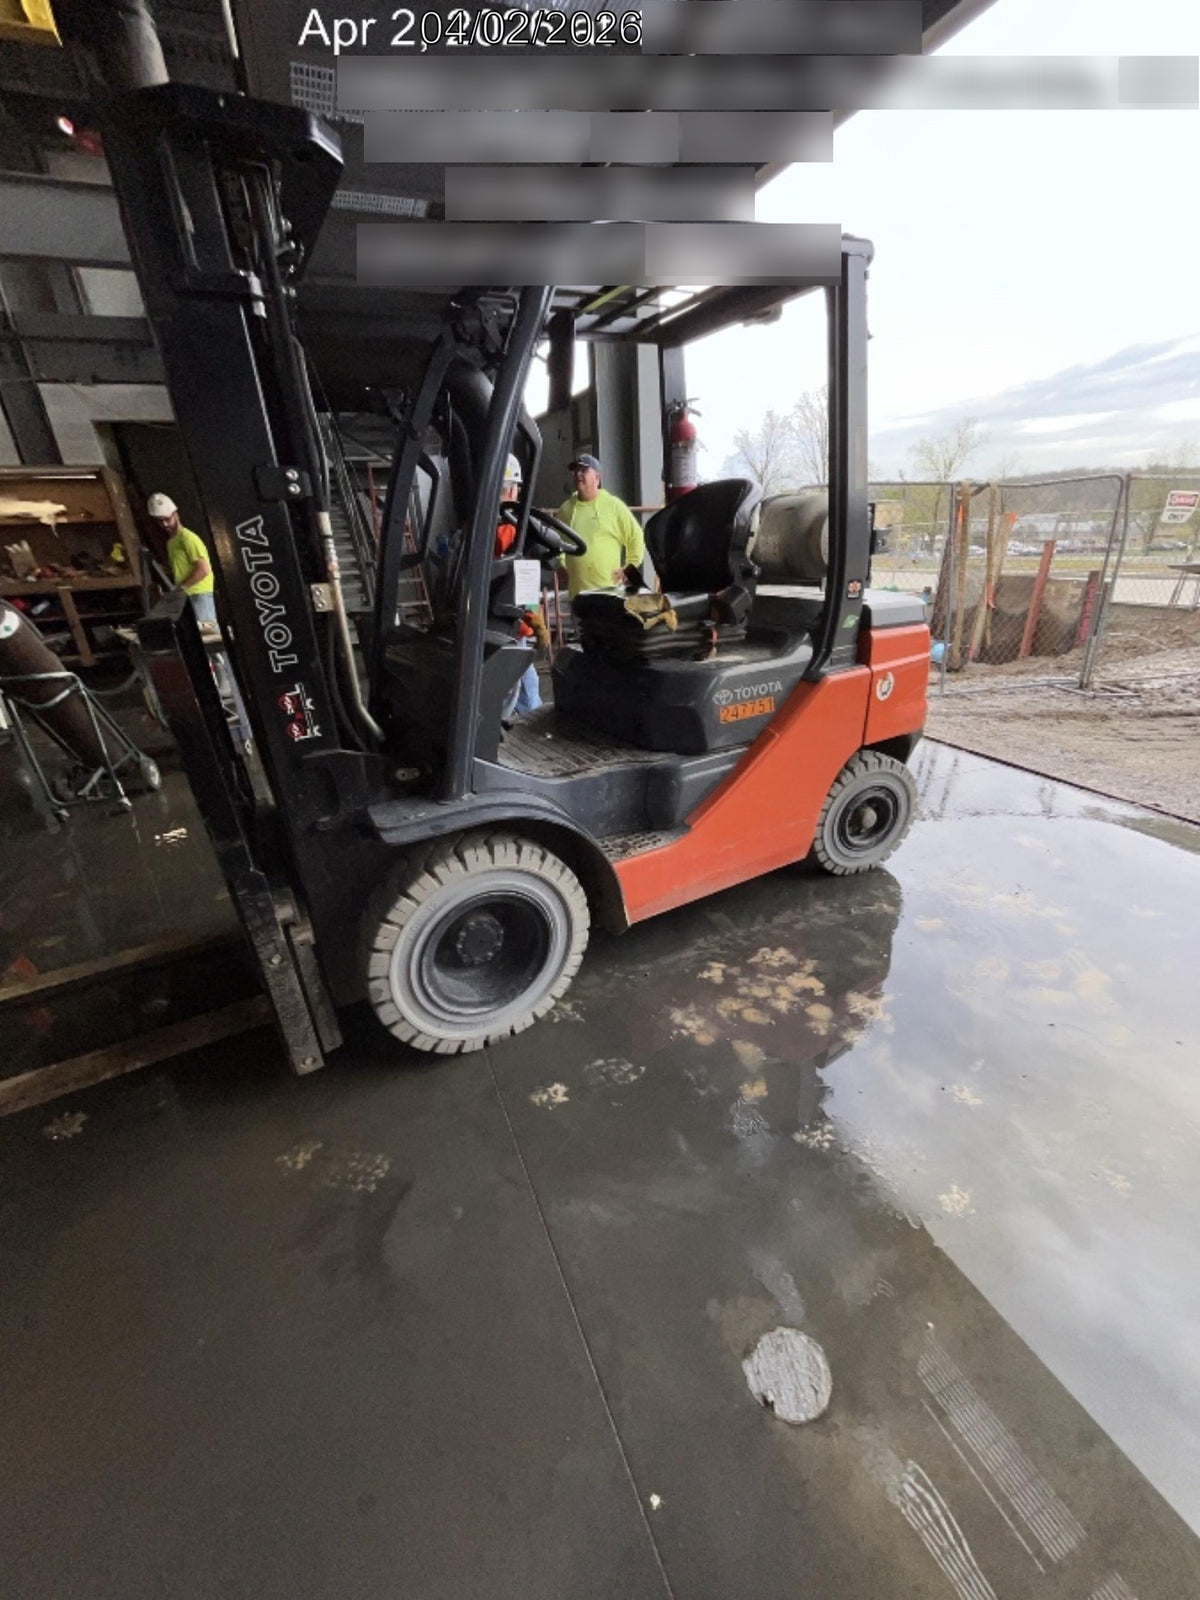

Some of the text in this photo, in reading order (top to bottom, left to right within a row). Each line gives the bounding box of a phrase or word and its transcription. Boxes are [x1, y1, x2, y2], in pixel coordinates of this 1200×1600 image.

[235, 514, 299, 673] TOYOTA
[734, 680, 783, 700] TOYOTA
[720, 697, 774, 723] 247751
